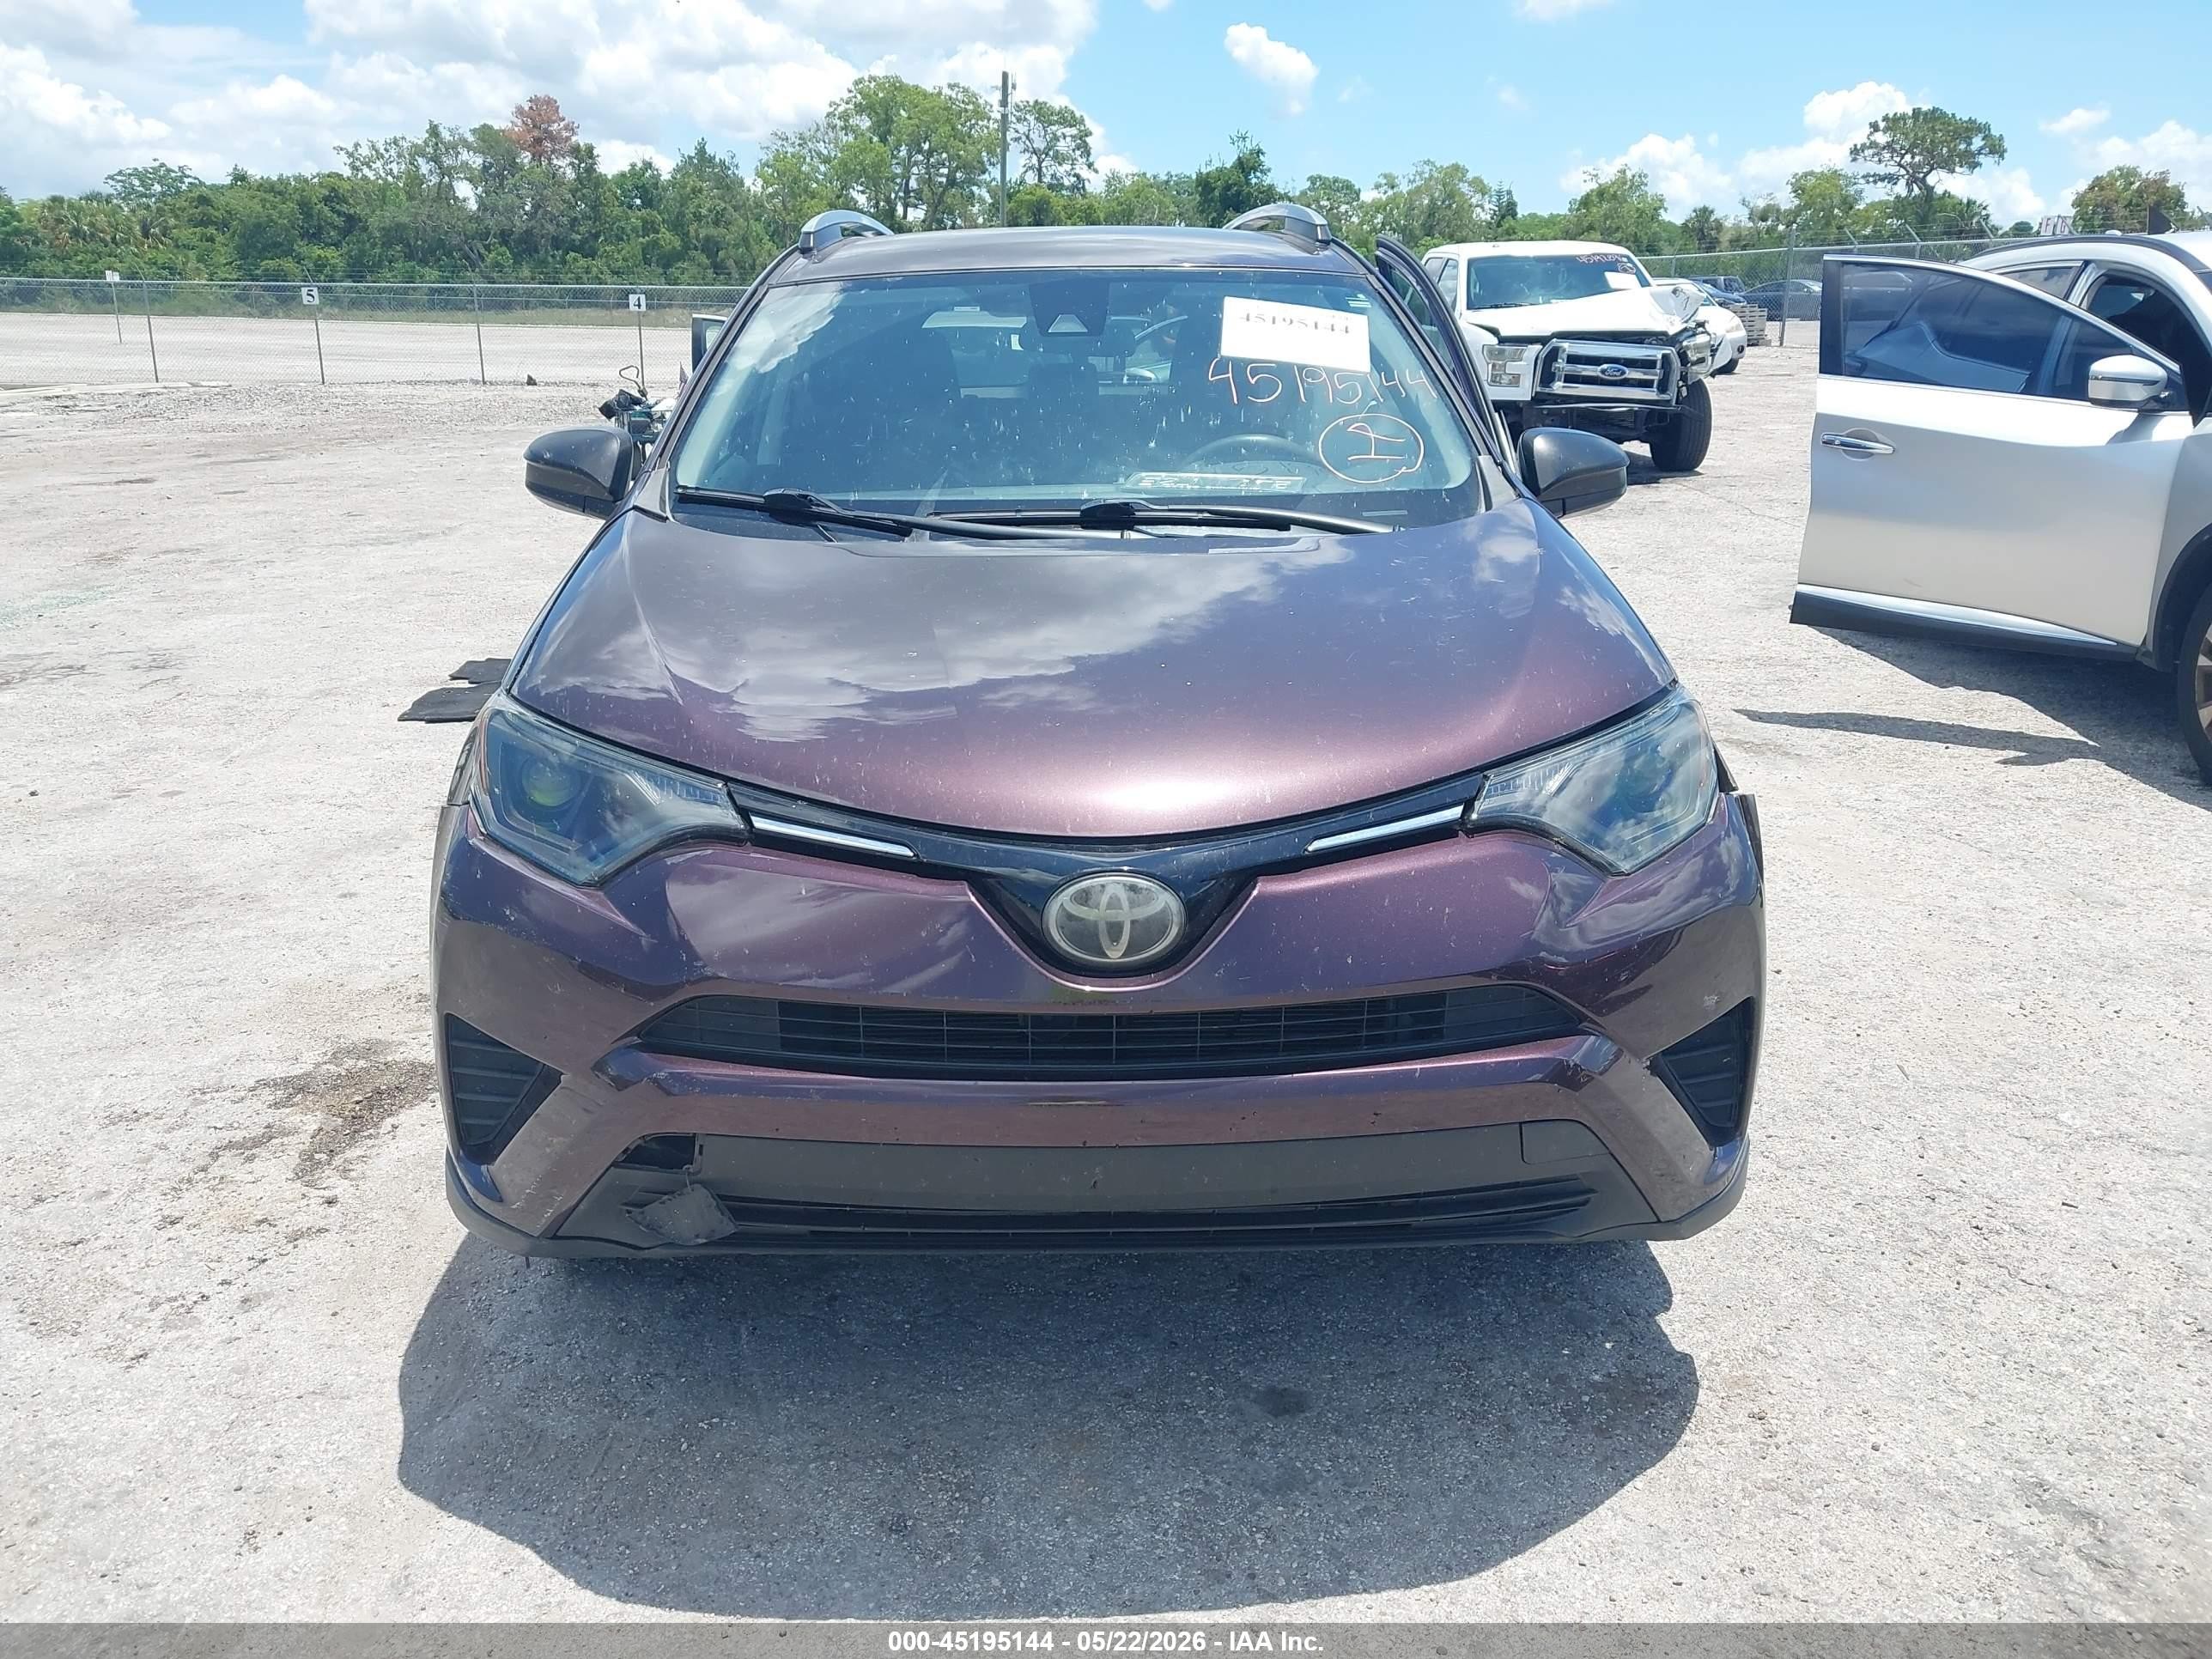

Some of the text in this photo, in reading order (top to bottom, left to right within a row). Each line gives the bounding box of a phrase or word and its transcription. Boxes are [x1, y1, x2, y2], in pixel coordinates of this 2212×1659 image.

[306, 289, 315, 303] 5
[633, 295, 642, 310] 4
[1207, 356, 1438, 405] 45195144
